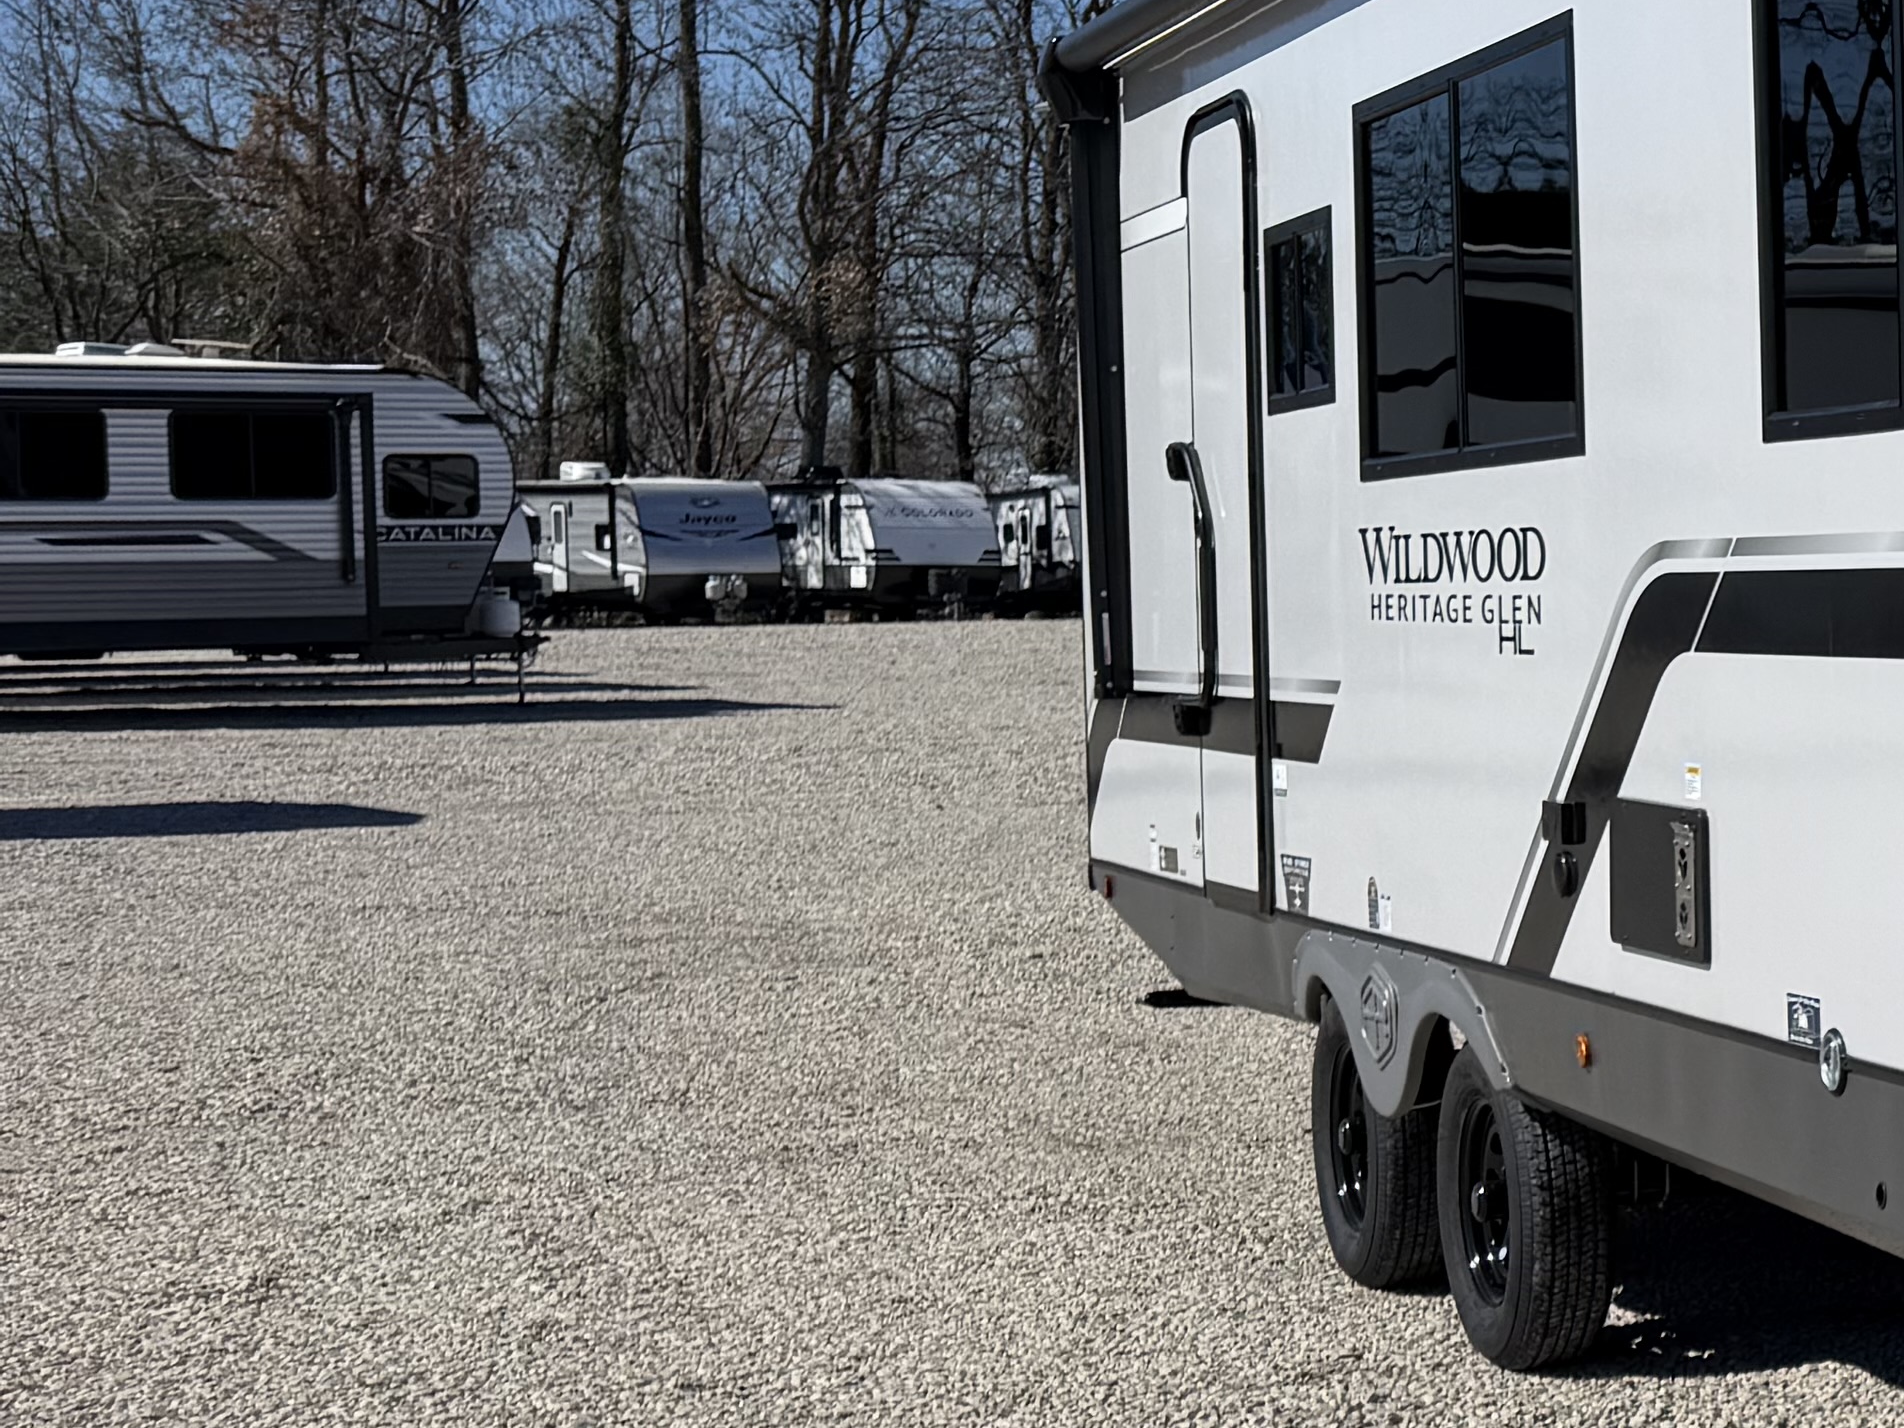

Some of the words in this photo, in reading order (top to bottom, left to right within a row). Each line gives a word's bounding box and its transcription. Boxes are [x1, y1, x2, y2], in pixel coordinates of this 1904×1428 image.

[376, 525, 497, 542] CATALINA
[679, 512, 737, 526] Jayco
[1358, 526, 1547, 586] WILDWOOD
[1371, 593, 1473, 624] HERITAGE
[1481, 594, 1542, 626] GLEN
[1499, 622, 1535, 656] HL
